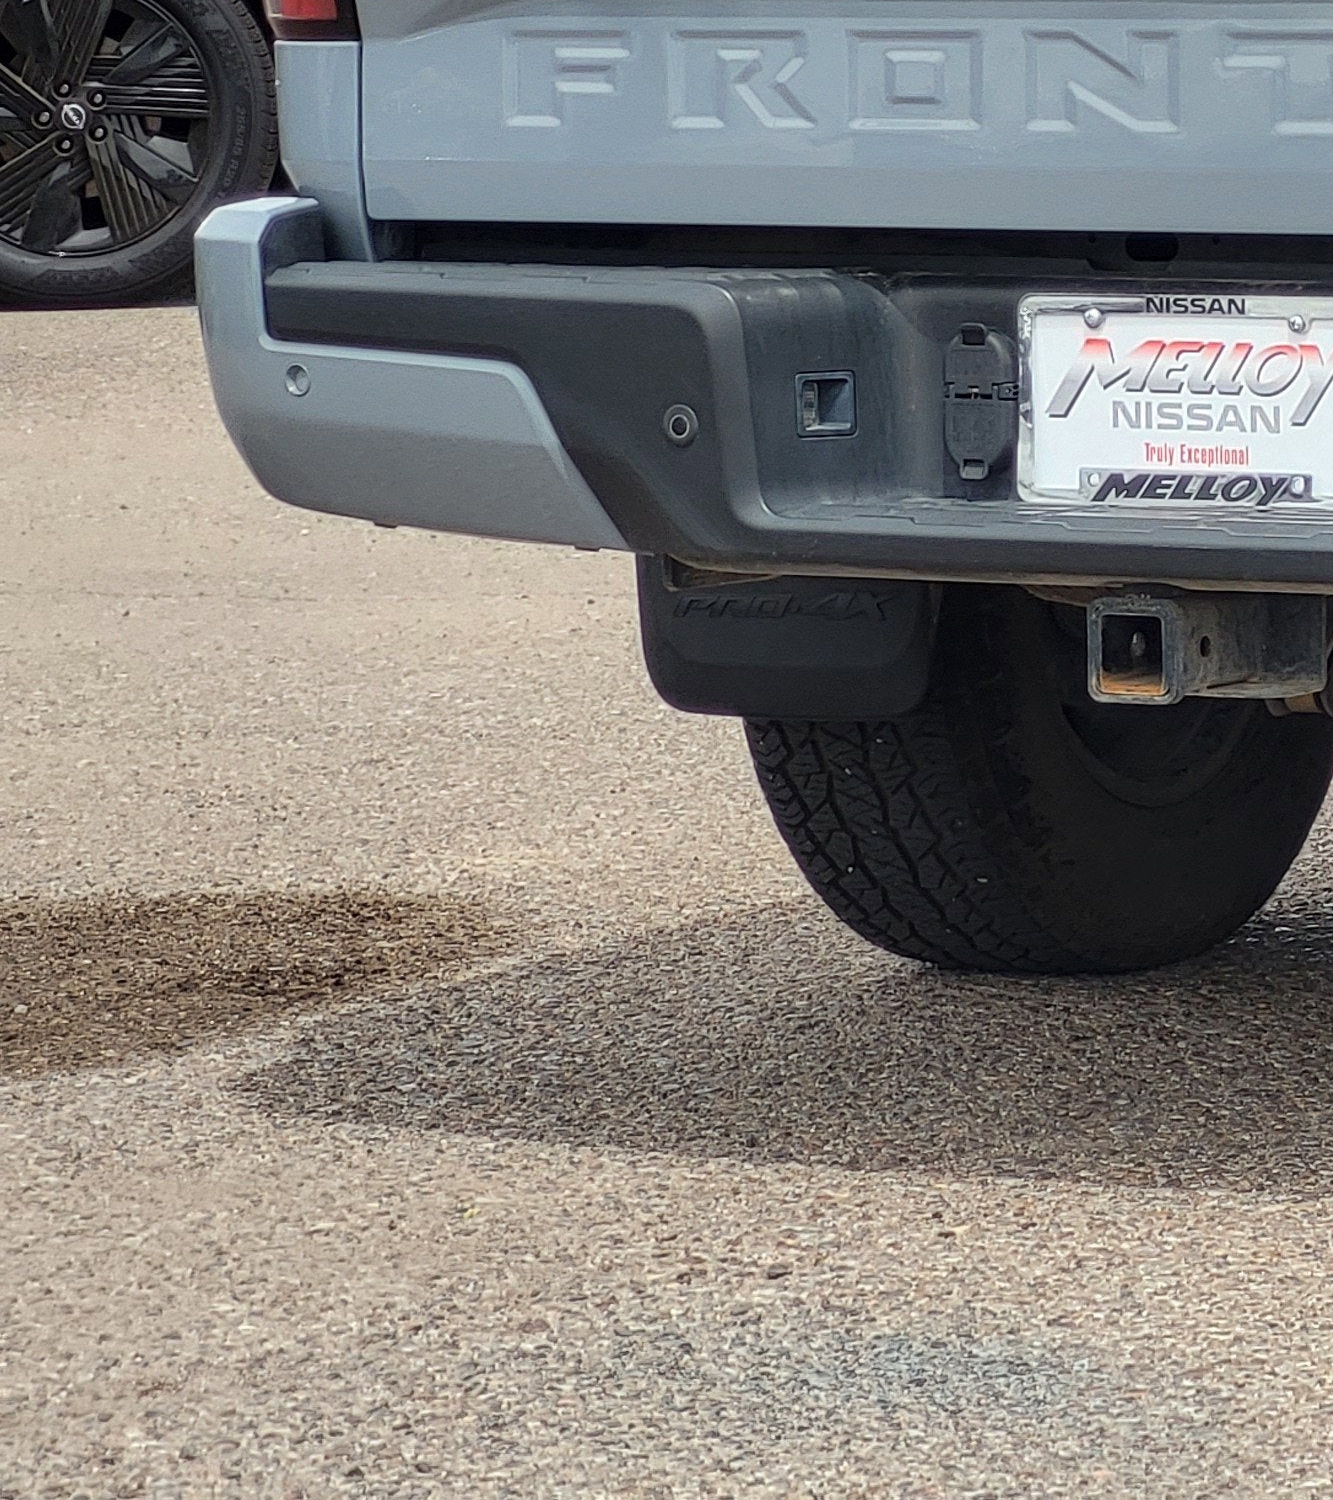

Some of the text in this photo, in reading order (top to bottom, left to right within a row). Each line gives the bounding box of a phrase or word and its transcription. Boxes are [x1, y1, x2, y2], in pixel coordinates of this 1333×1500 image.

[1145, 297, 1246, 315] NISSAN
[1111, 401, 1281, 435] NISSAN
[1144, 443, 1250, 468] Truly Exceptional
[1091, 473, 1289, 506] MELLOY
